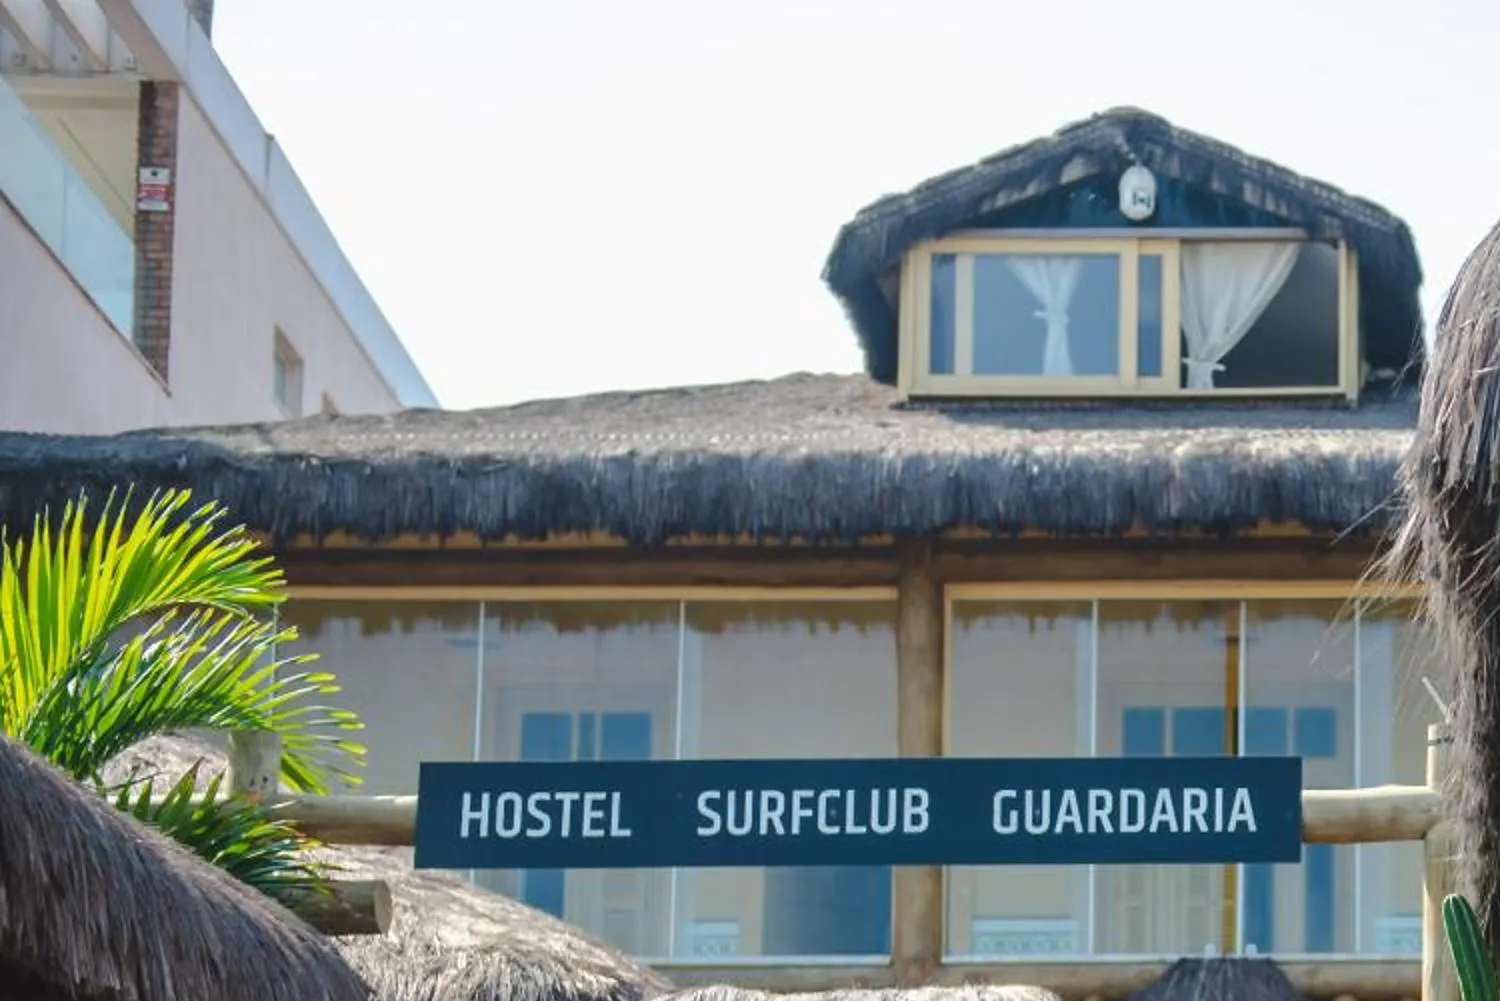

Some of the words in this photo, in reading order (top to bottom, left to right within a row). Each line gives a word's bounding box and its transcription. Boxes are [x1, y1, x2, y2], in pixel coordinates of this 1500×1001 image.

[460, 791, 632, 839] HOSTEL
[697, 788, 930, 837] SURFCLUB
[992, 786, 1258, 836] GUARDARIA
